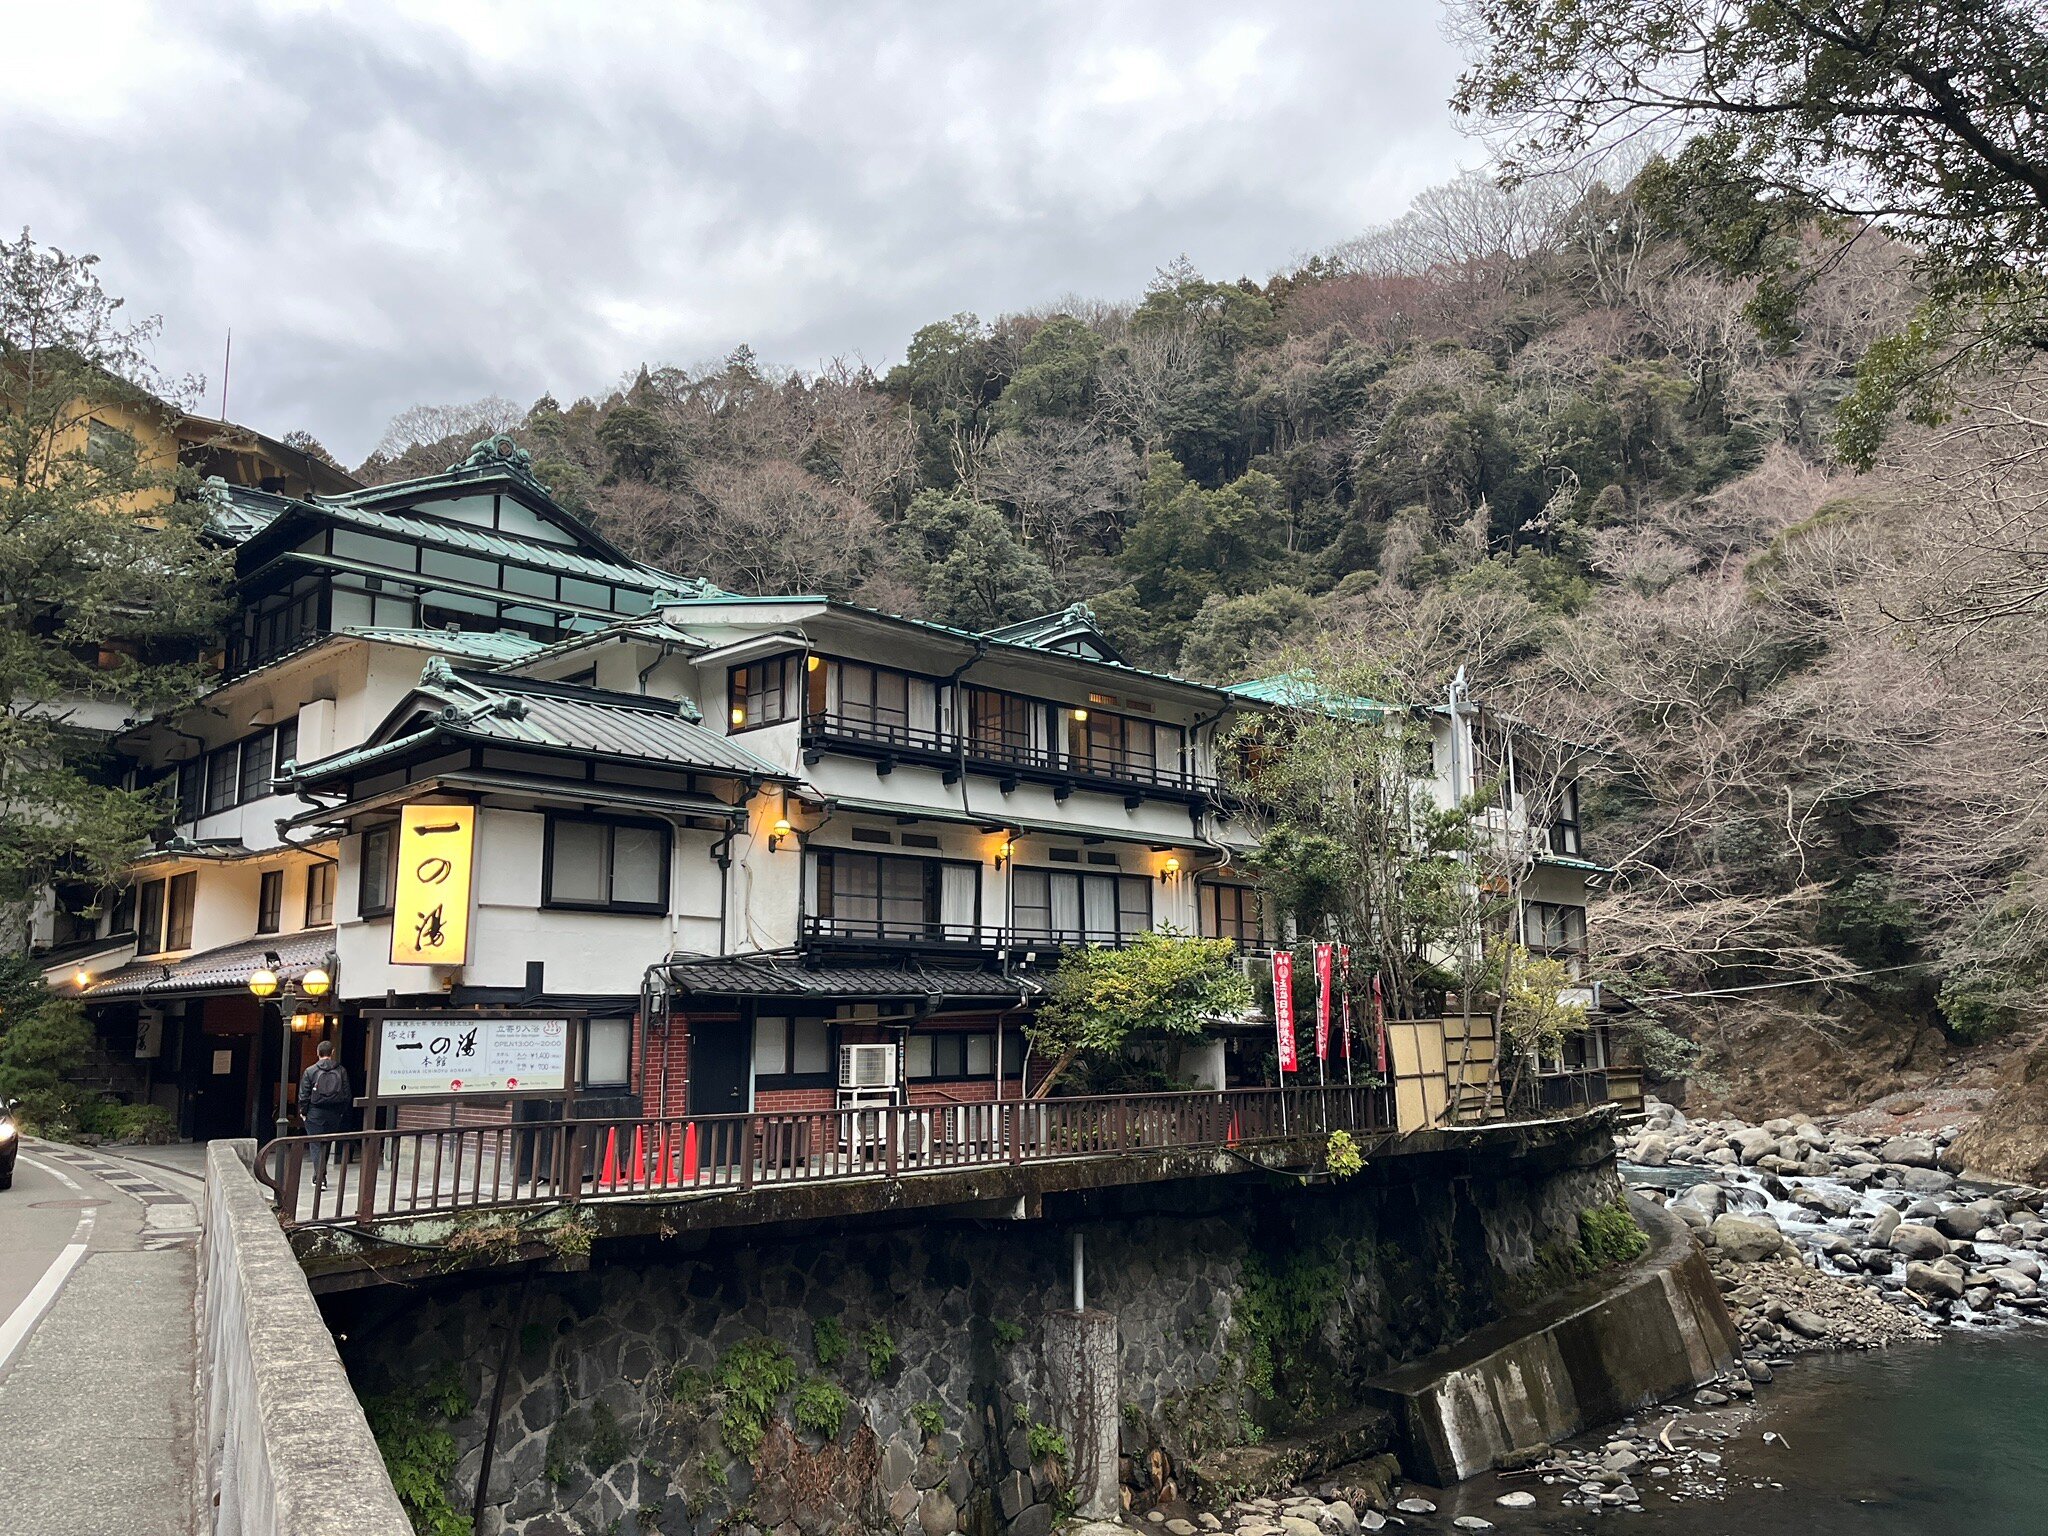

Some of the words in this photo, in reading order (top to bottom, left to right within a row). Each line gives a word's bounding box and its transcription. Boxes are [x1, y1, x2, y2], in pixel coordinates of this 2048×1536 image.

[413, 821, 461, 951] 一の湯
[395, 1027, 478, 1057] 一の湯
[421, 1056, 448, 1067] 本館
